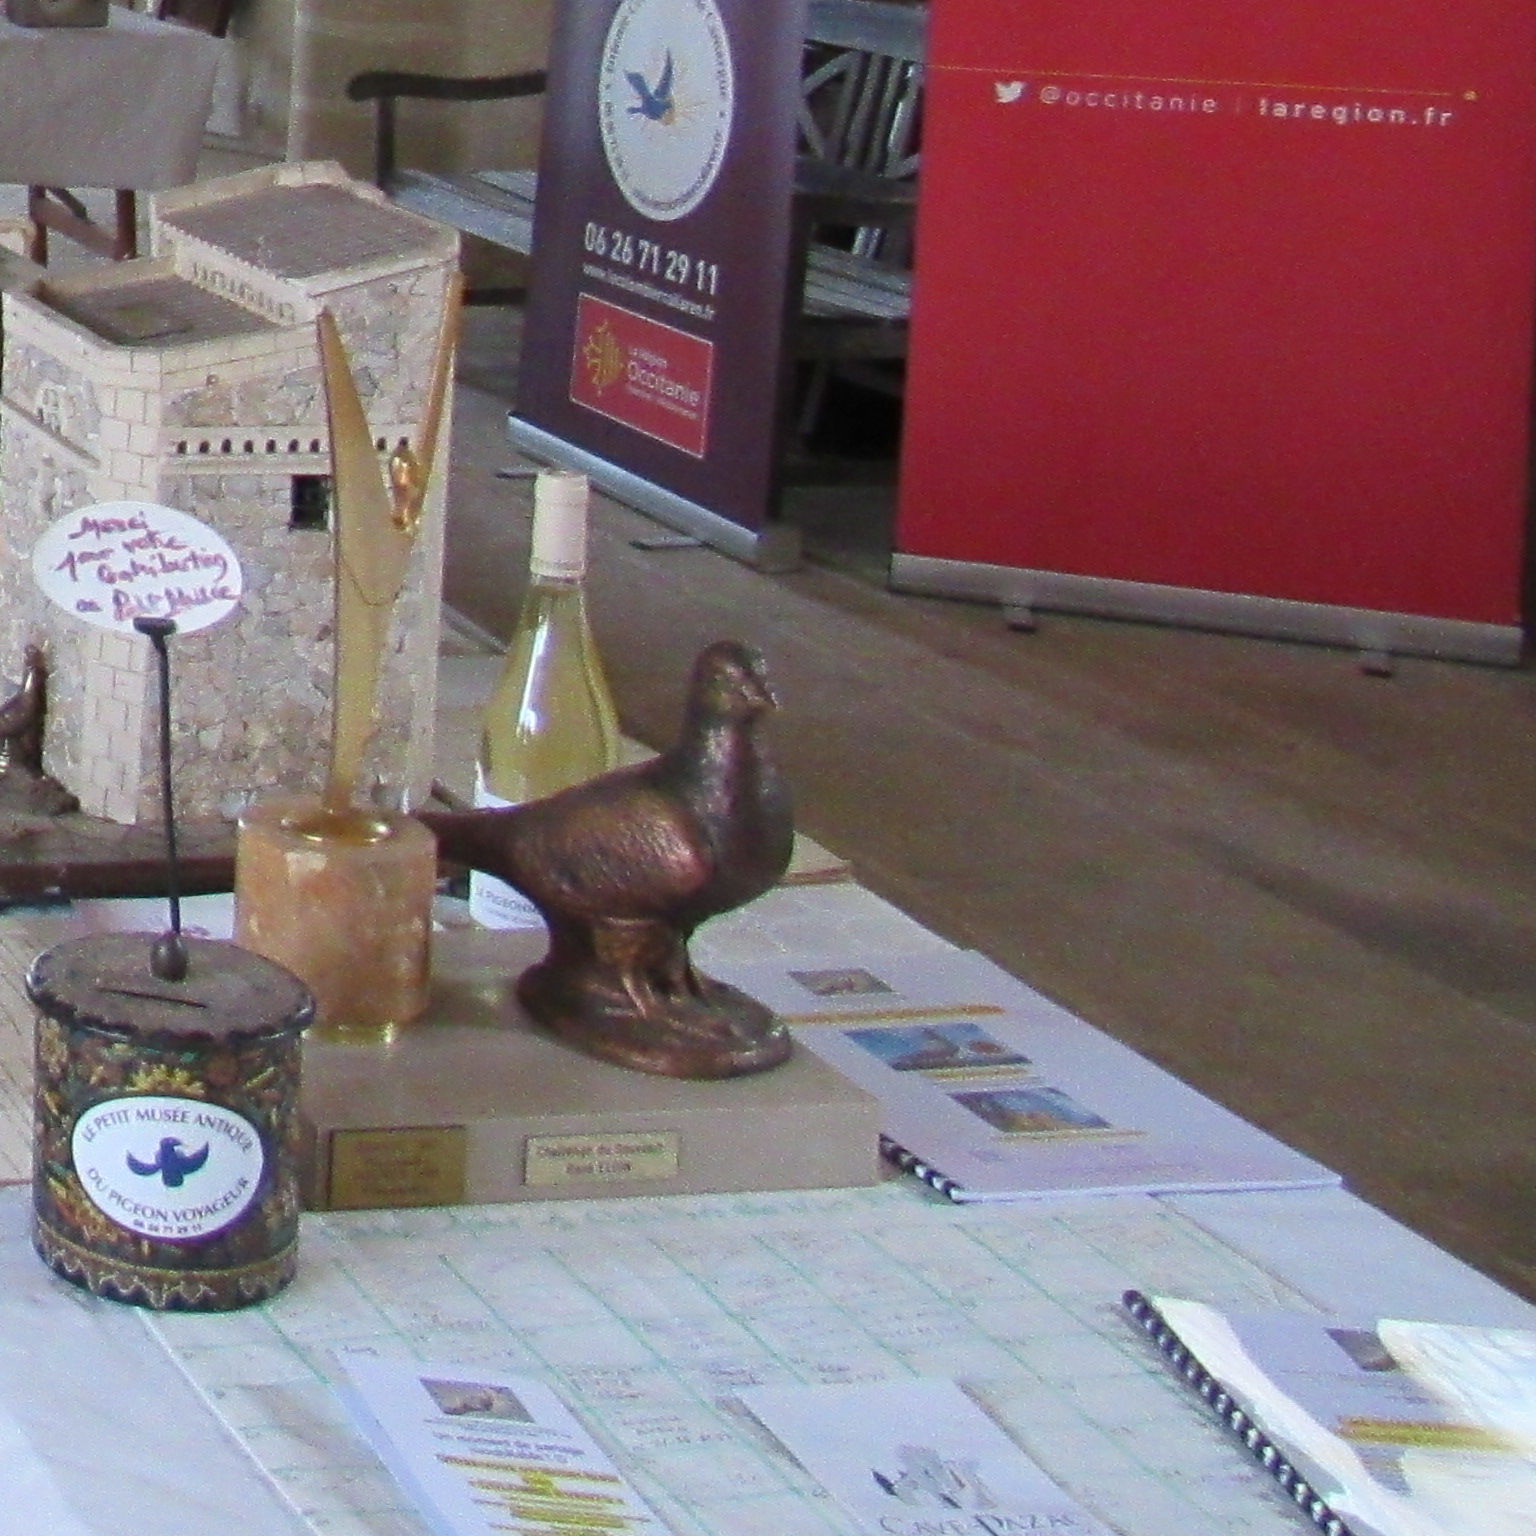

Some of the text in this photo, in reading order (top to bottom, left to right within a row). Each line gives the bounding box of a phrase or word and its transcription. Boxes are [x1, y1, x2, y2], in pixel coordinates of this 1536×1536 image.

[1040, 84, 1453, 127] @occitanie laregion.fr
[585, 222, 718, 296] 06 26 71 29 11
[628, 360, 700, 407] Occitanie
[82, 1123, 95, 1143] LE
[93, 1109, 131, 1131] PETIT
[191, 1113, 254, 1154] ANTIQUE
[87, 1167, 250, 1222] DU PIGEON VOYAGEUR
